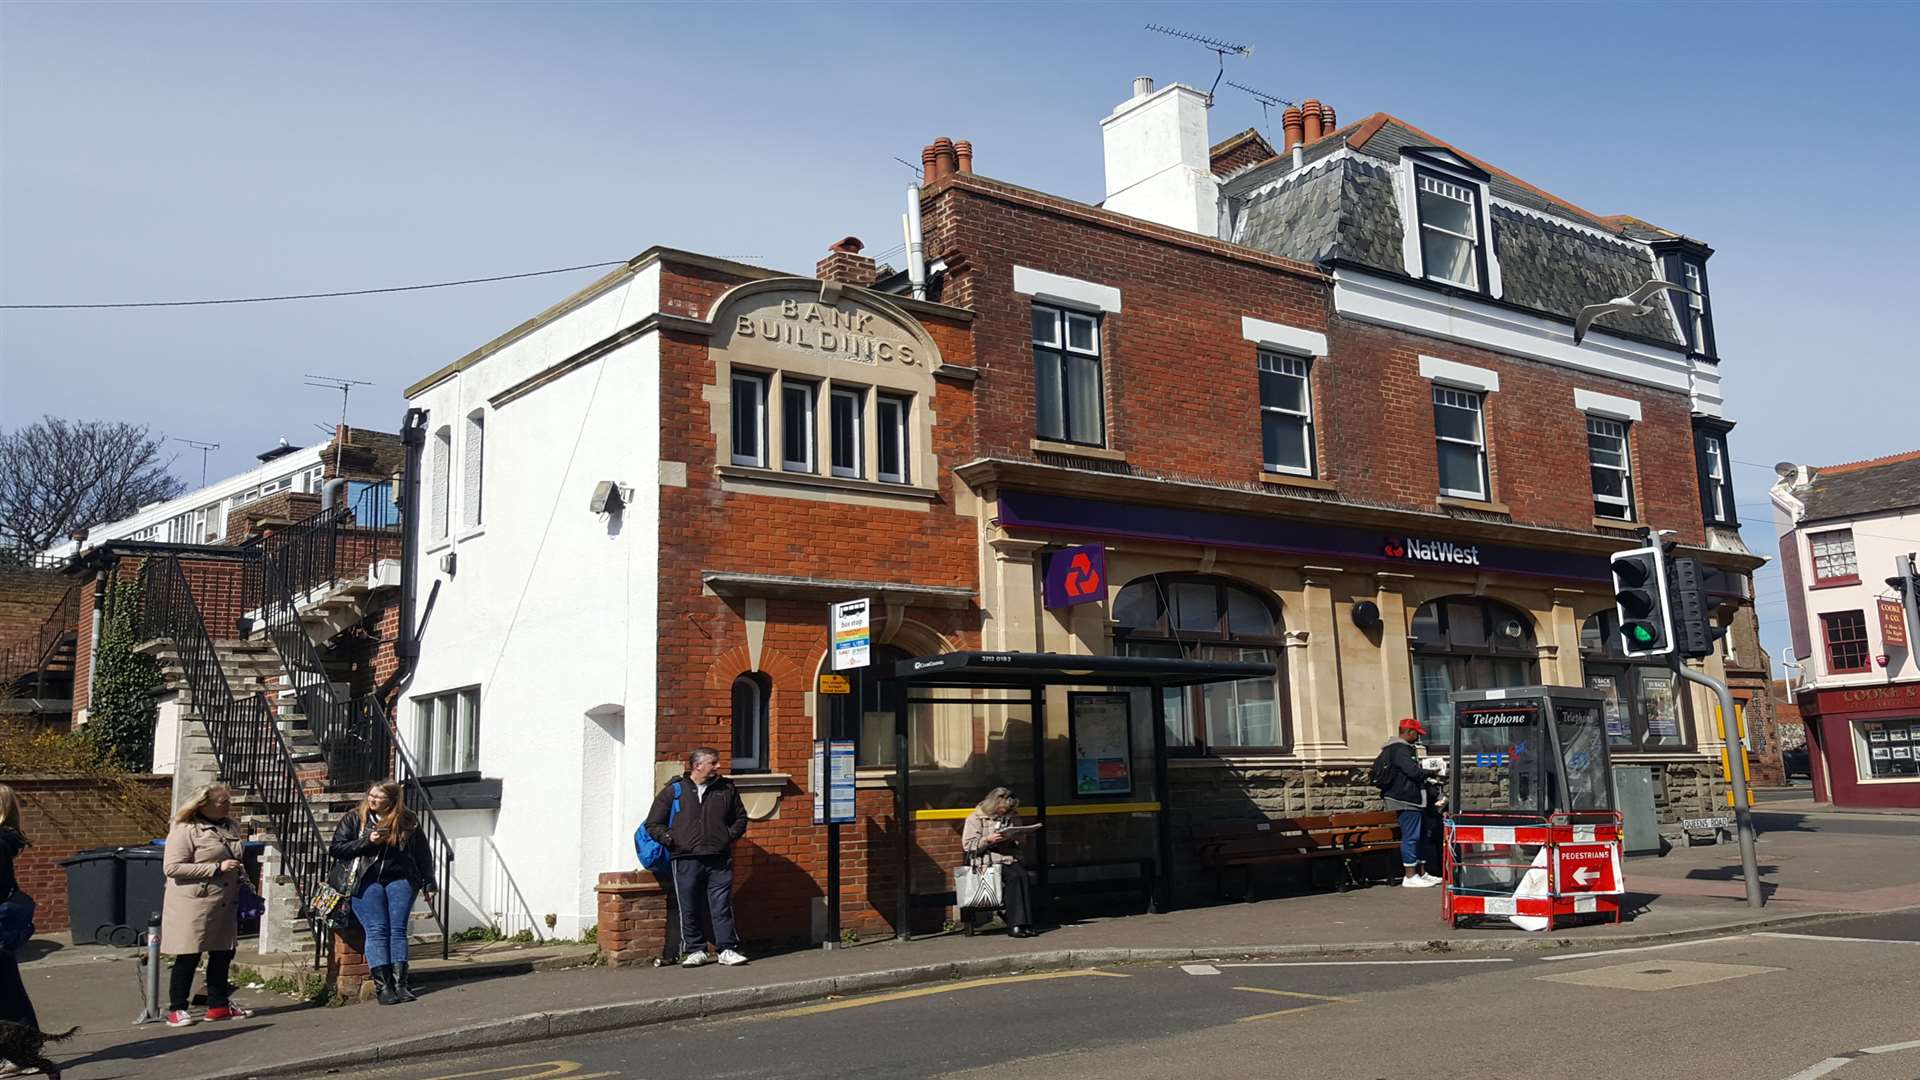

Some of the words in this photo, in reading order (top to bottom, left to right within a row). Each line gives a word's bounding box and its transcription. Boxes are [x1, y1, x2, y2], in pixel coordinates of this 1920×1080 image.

[781, 299, 874, 333] BANK
[1406, 538, 1480, 565] NatWest
[1881, 603, 1901, 613] COOKE
[1906, 686, 1916, 697] &
[1472, 713, 1525, 726] Telephone
[1685, 820, 1709, 828] QUEENS
[1711, 818, 1727, 826] ROAD
[1561, 851, 1610, 860] PEDESTRIANS
